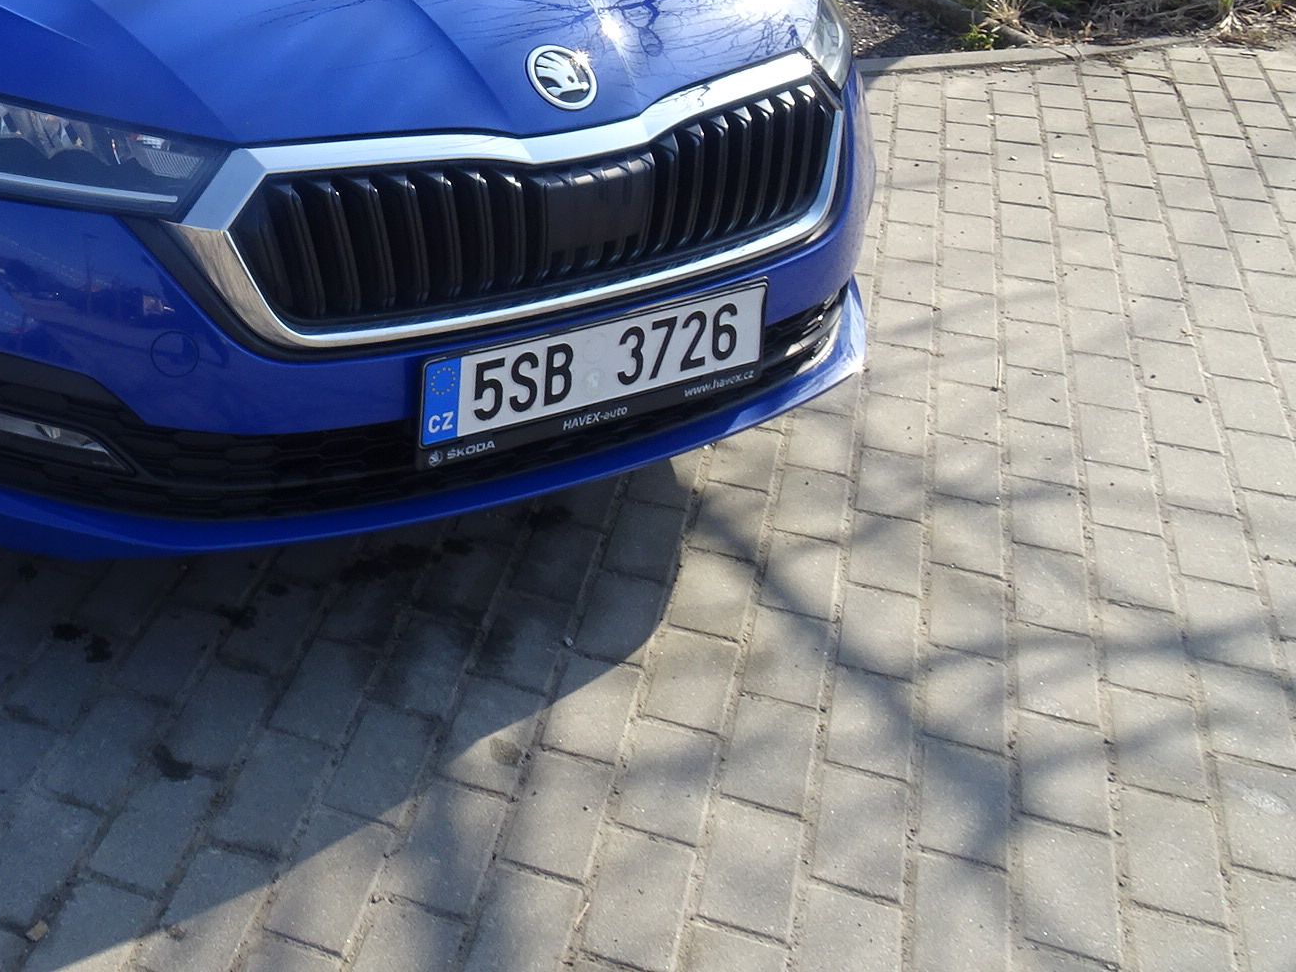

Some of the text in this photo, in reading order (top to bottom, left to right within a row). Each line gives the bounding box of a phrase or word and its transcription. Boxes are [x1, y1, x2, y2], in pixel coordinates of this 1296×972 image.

[473, 302, 738, 422] 5SB 3726
[428, 412, 454, 434] CZ
[562, 406, 629, 431] HAVEX-auto
[447, 440, 496, 460] ŠKODA
